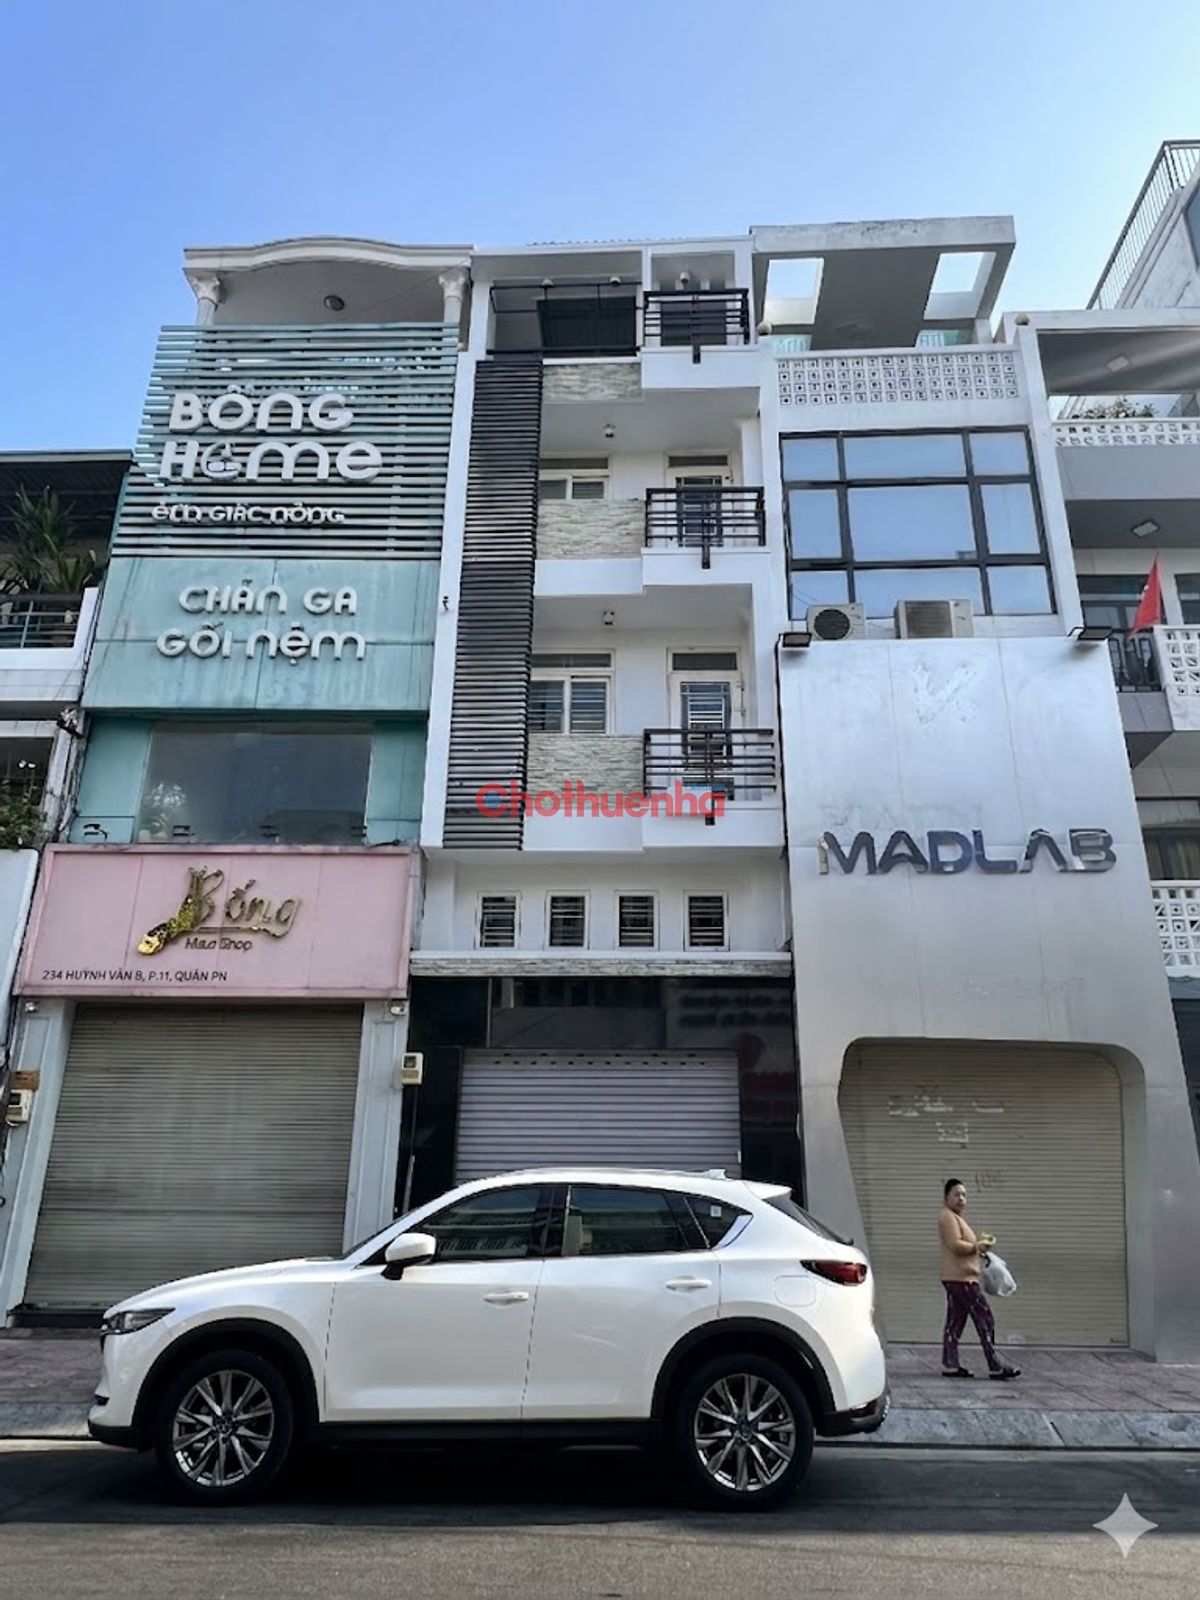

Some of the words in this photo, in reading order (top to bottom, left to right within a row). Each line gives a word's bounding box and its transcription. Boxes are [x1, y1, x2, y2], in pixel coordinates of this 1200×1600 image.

[302, 585, 358, 616] GA
[818, 828, 1117, 875] MADLAB
[42, 969, 63, 981] 234
[210, 970, 228, 982] PN
